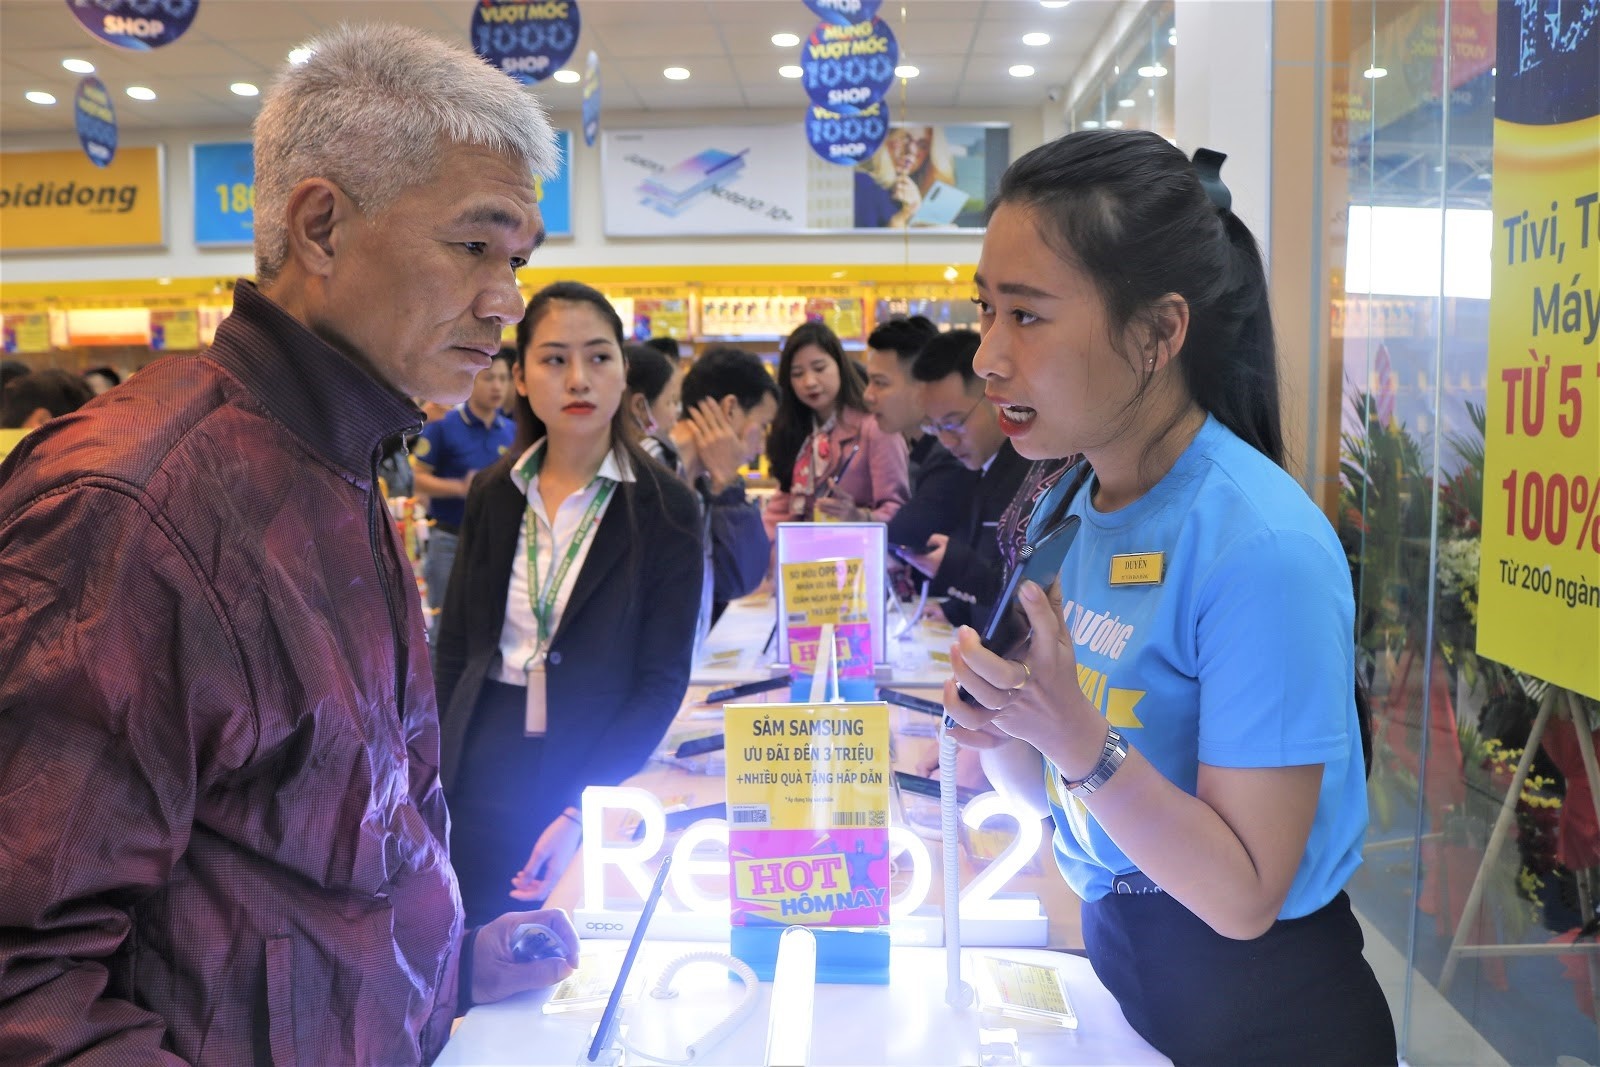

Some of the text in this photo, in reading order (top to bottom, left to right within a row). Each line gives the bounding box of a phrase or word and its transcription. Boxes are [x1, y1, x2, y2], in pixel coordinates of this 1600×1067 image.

[103, 15, 165, 37] SHOP
[477, 21, 573, 54] 1000
[502, 55, 550, 73] SHOP
[806, 54, 893, 88] 1000
[828, 87, 871, 105] SHOP
[810, 117, 884, 143] 1000
[829, 142, 866, 158] SHOP
[1503, 192, 1600, 266] Tivi, T
[1532, 273, 1600, 345] Máy
[1502, 349, 1583, 438] TỪ 5
[1502, 469, 1600, 555] 100%
[1500, 559, 1600, 608] Từ 200 ngàn
[798, 640, 847, 662] HT
[753, 714, 864, 736] SẮM SAMSUNG
[744, 745, 763, 761] ƯU
[766, 743, 790, 761] ĐÃI
[824, 747, 832, 761] 3
[834, 743, 874, 764] TRIỆU
[781, 769, 803, 786] QUÀ
[805, 769, 833, 787] TẶNG
[837, 769, 858, 784] HẤP
[958, 791, 1043, 920] 2
[749, 857, 842, 895] HOT
[585, 922, 624, 931] oppo
